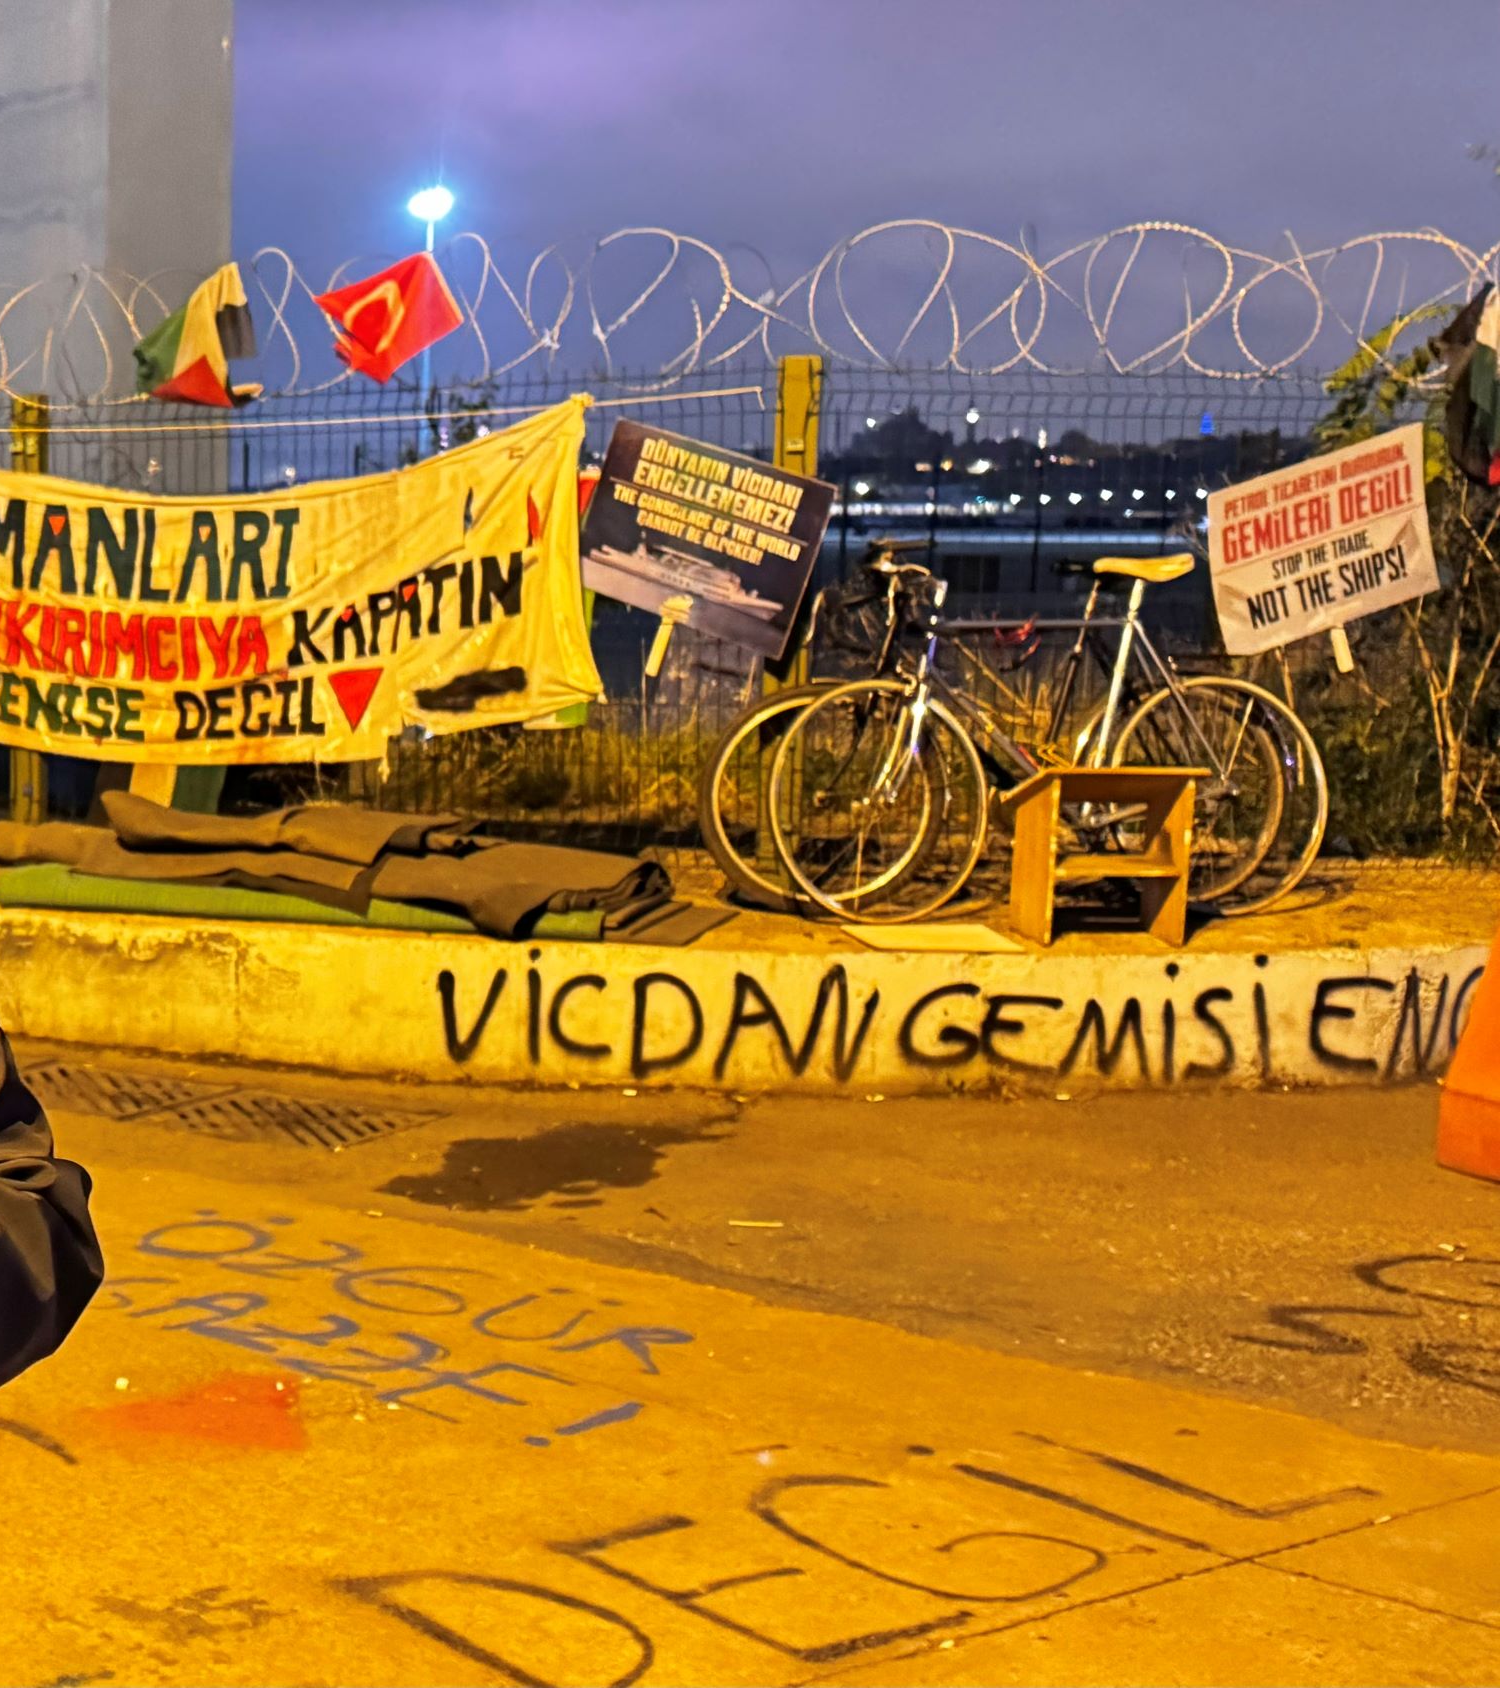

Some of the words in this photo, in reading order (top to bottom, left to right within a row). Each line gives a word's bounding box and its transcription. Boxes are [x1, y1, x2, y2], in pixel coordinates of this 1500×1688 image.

[613, 483, 639, 507] THE
[712, 517, 731, 536] OF
[731, 523, 756, 546] THE
[756, 531, 802, 562] WORLD
[1271, 555, 1304, 580] STOP
[1307, 543, 1330, 569] THE
[286, 550, 524, 667] KAPATIN
[1246, 583, 1290, 630] NOT
[1293, 568, 1337, 615] THE
[1337, 544, 1408, 597] SHIPS!
[436, 947, 880, 1083] VİCDAN
[897, 953, 1272, 1084] GEMİSİ
